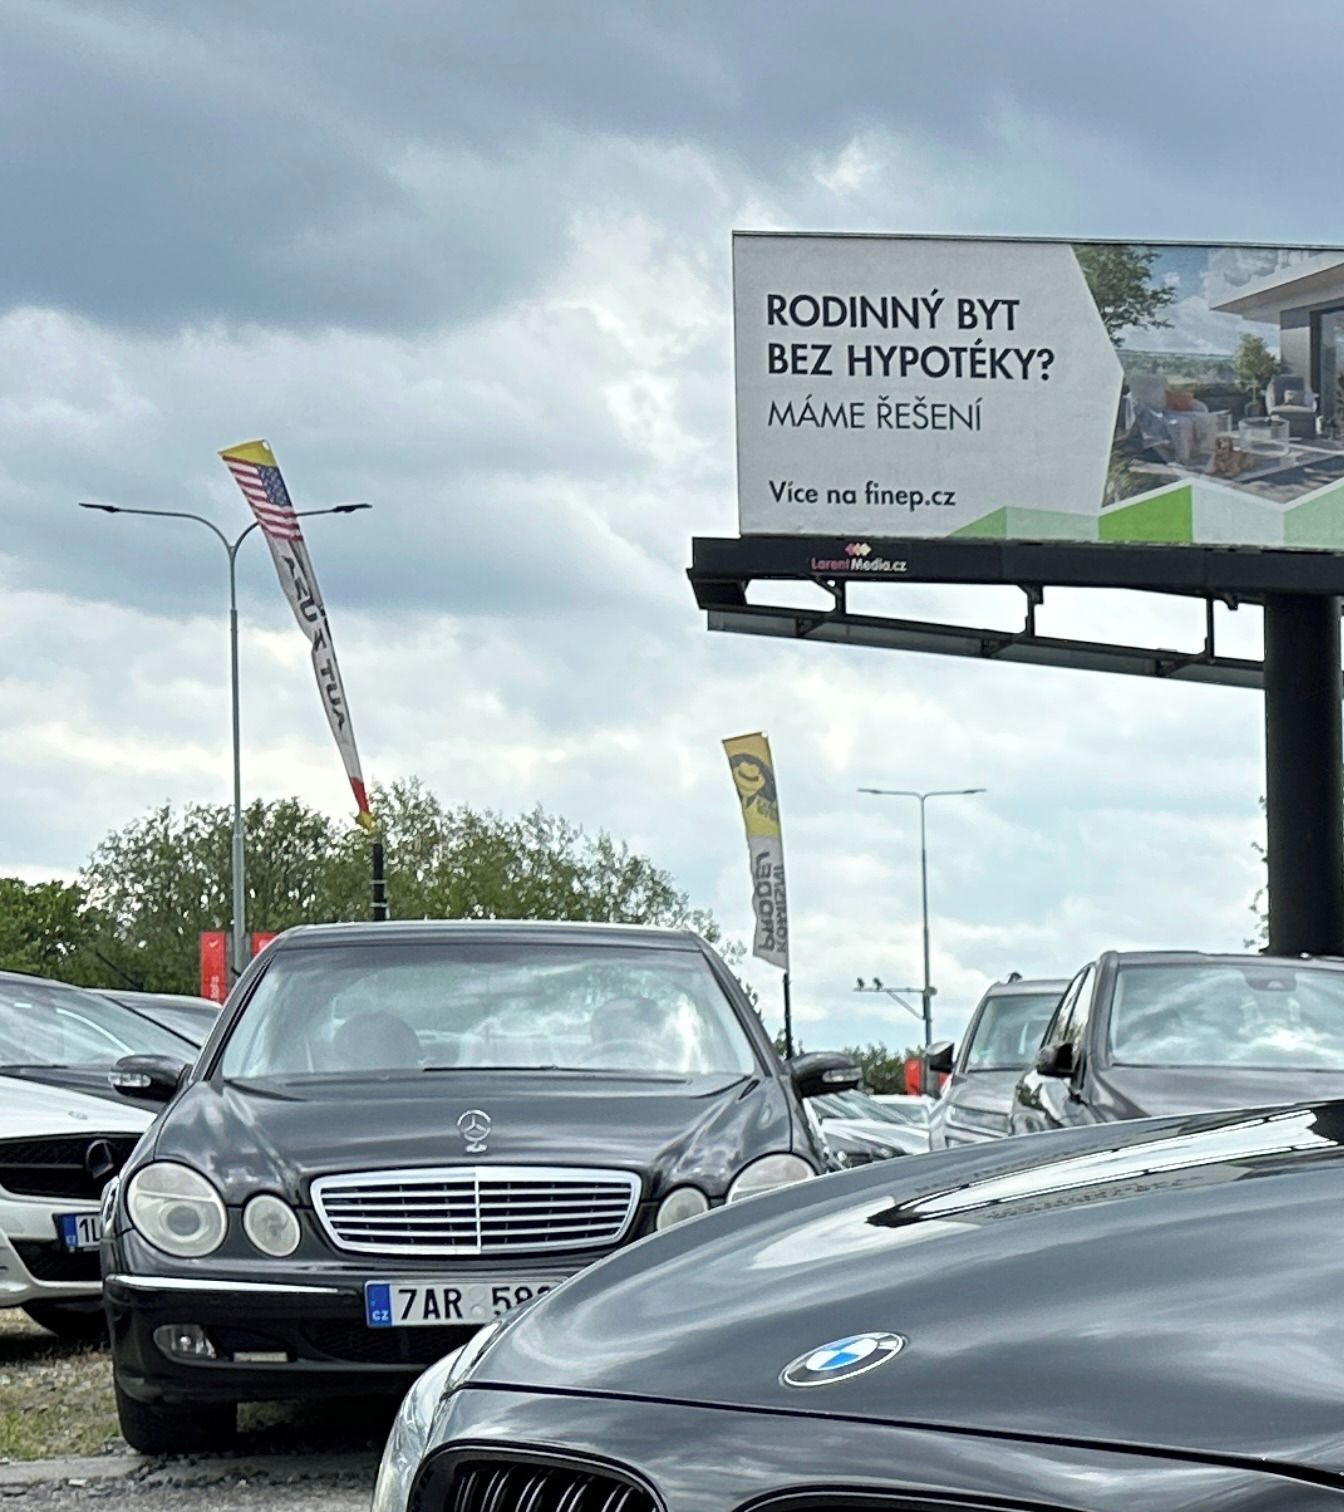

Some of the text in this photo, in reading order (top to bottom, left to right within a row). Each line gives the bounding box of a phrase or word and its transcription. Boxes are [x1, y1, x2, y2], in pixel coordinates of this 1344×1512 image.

[767, 288, 1020, 330] RODINNÝ BYT
[768, 337, 1055, 381] BEZ HYPOTÉKY?
[768, 393, 983, 431] MÁME ŘEŠENÍ
[769, 479, 957, 512] Více na finep.cz
[398, 1287, 463, 1321] 7AR
